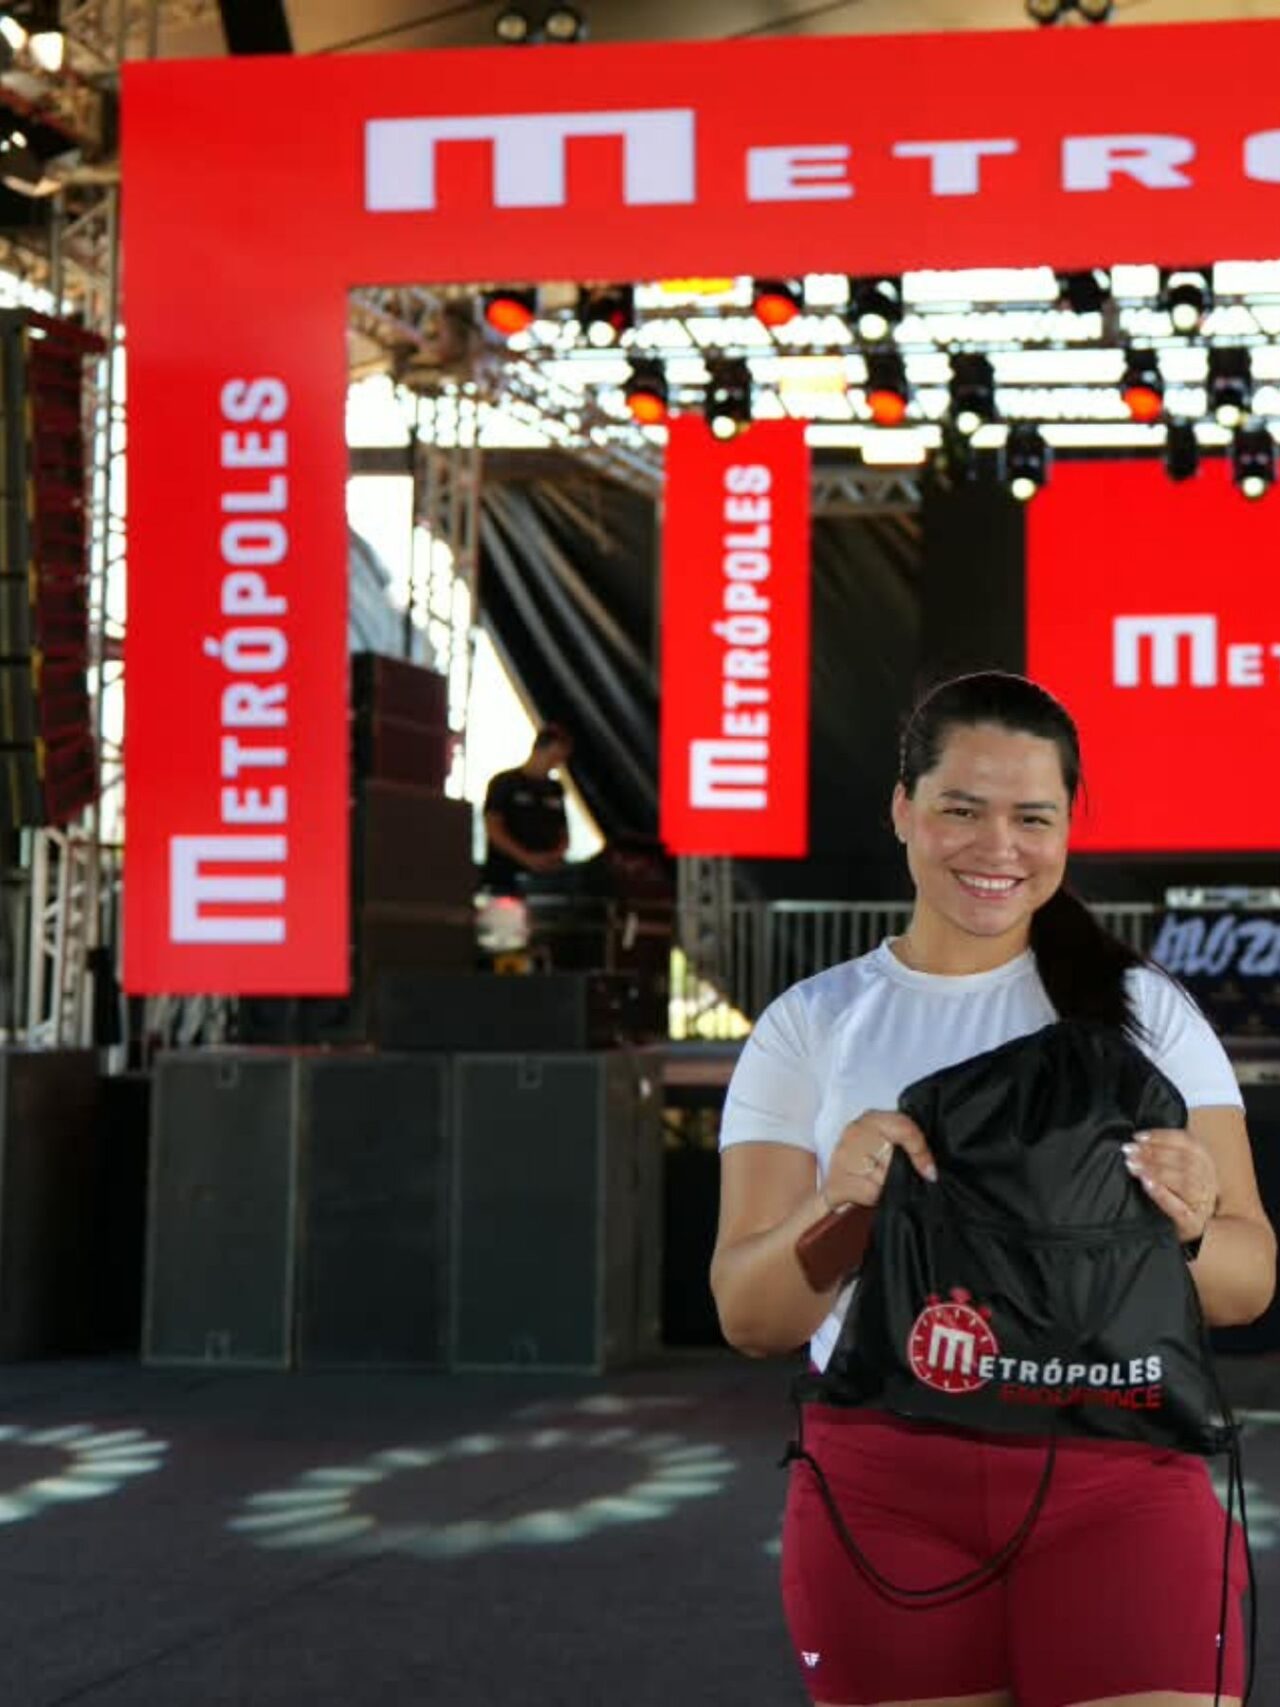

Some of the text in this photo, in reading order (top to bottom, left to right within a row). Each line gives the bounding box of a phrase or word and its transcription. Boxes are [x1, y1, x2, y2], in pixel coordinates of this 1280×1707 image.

[168, 377, 289, 945] METRÓPOLES
[689, 464, 773, 811] METRÓPOLES
[926, 1323, 1163, 1386] METRÓPOLES
